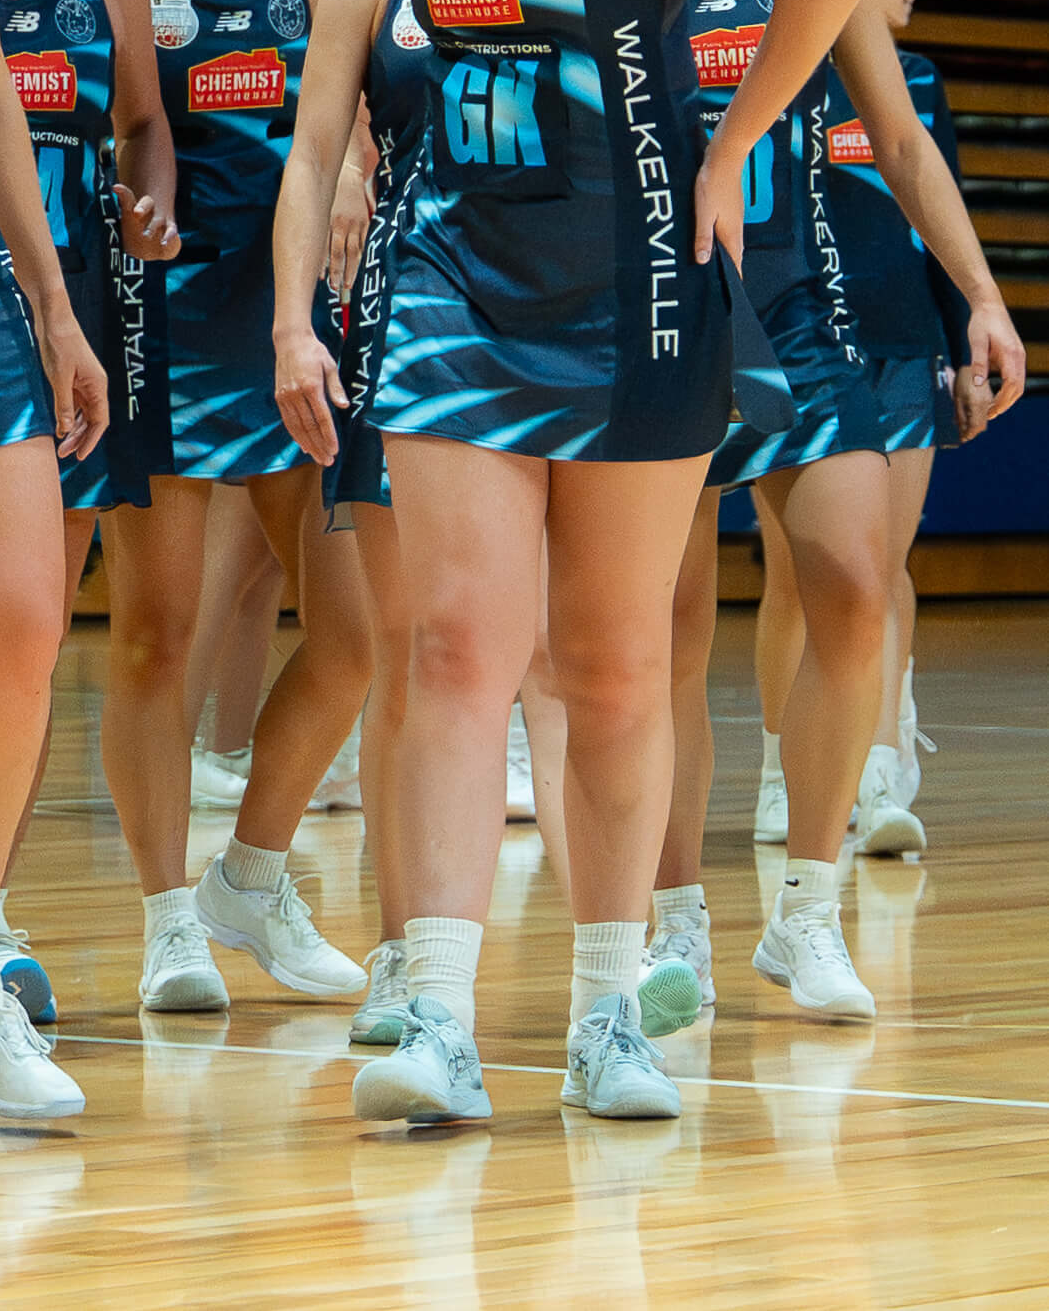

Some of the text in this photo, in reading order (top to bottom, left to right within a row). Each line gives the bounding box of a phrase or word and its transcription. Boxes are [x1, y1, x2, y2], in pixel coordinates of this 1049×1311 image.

[433, 4, 511, 18] WAREHOUSE
[695, 46, 759, 68] HEMIS
[11, 72, 71, 92] EMIST
[195, 70, 281, 92] CHEMIST
[23, 93, 69, 103] HOUSE
[195, 90, 277, 104] WAREHOUSE
[442, 55, 548, 166] GK
[28, 131, 79, 146] UCTIONS
[613, 20, 679, 360] WALKERVILLE
